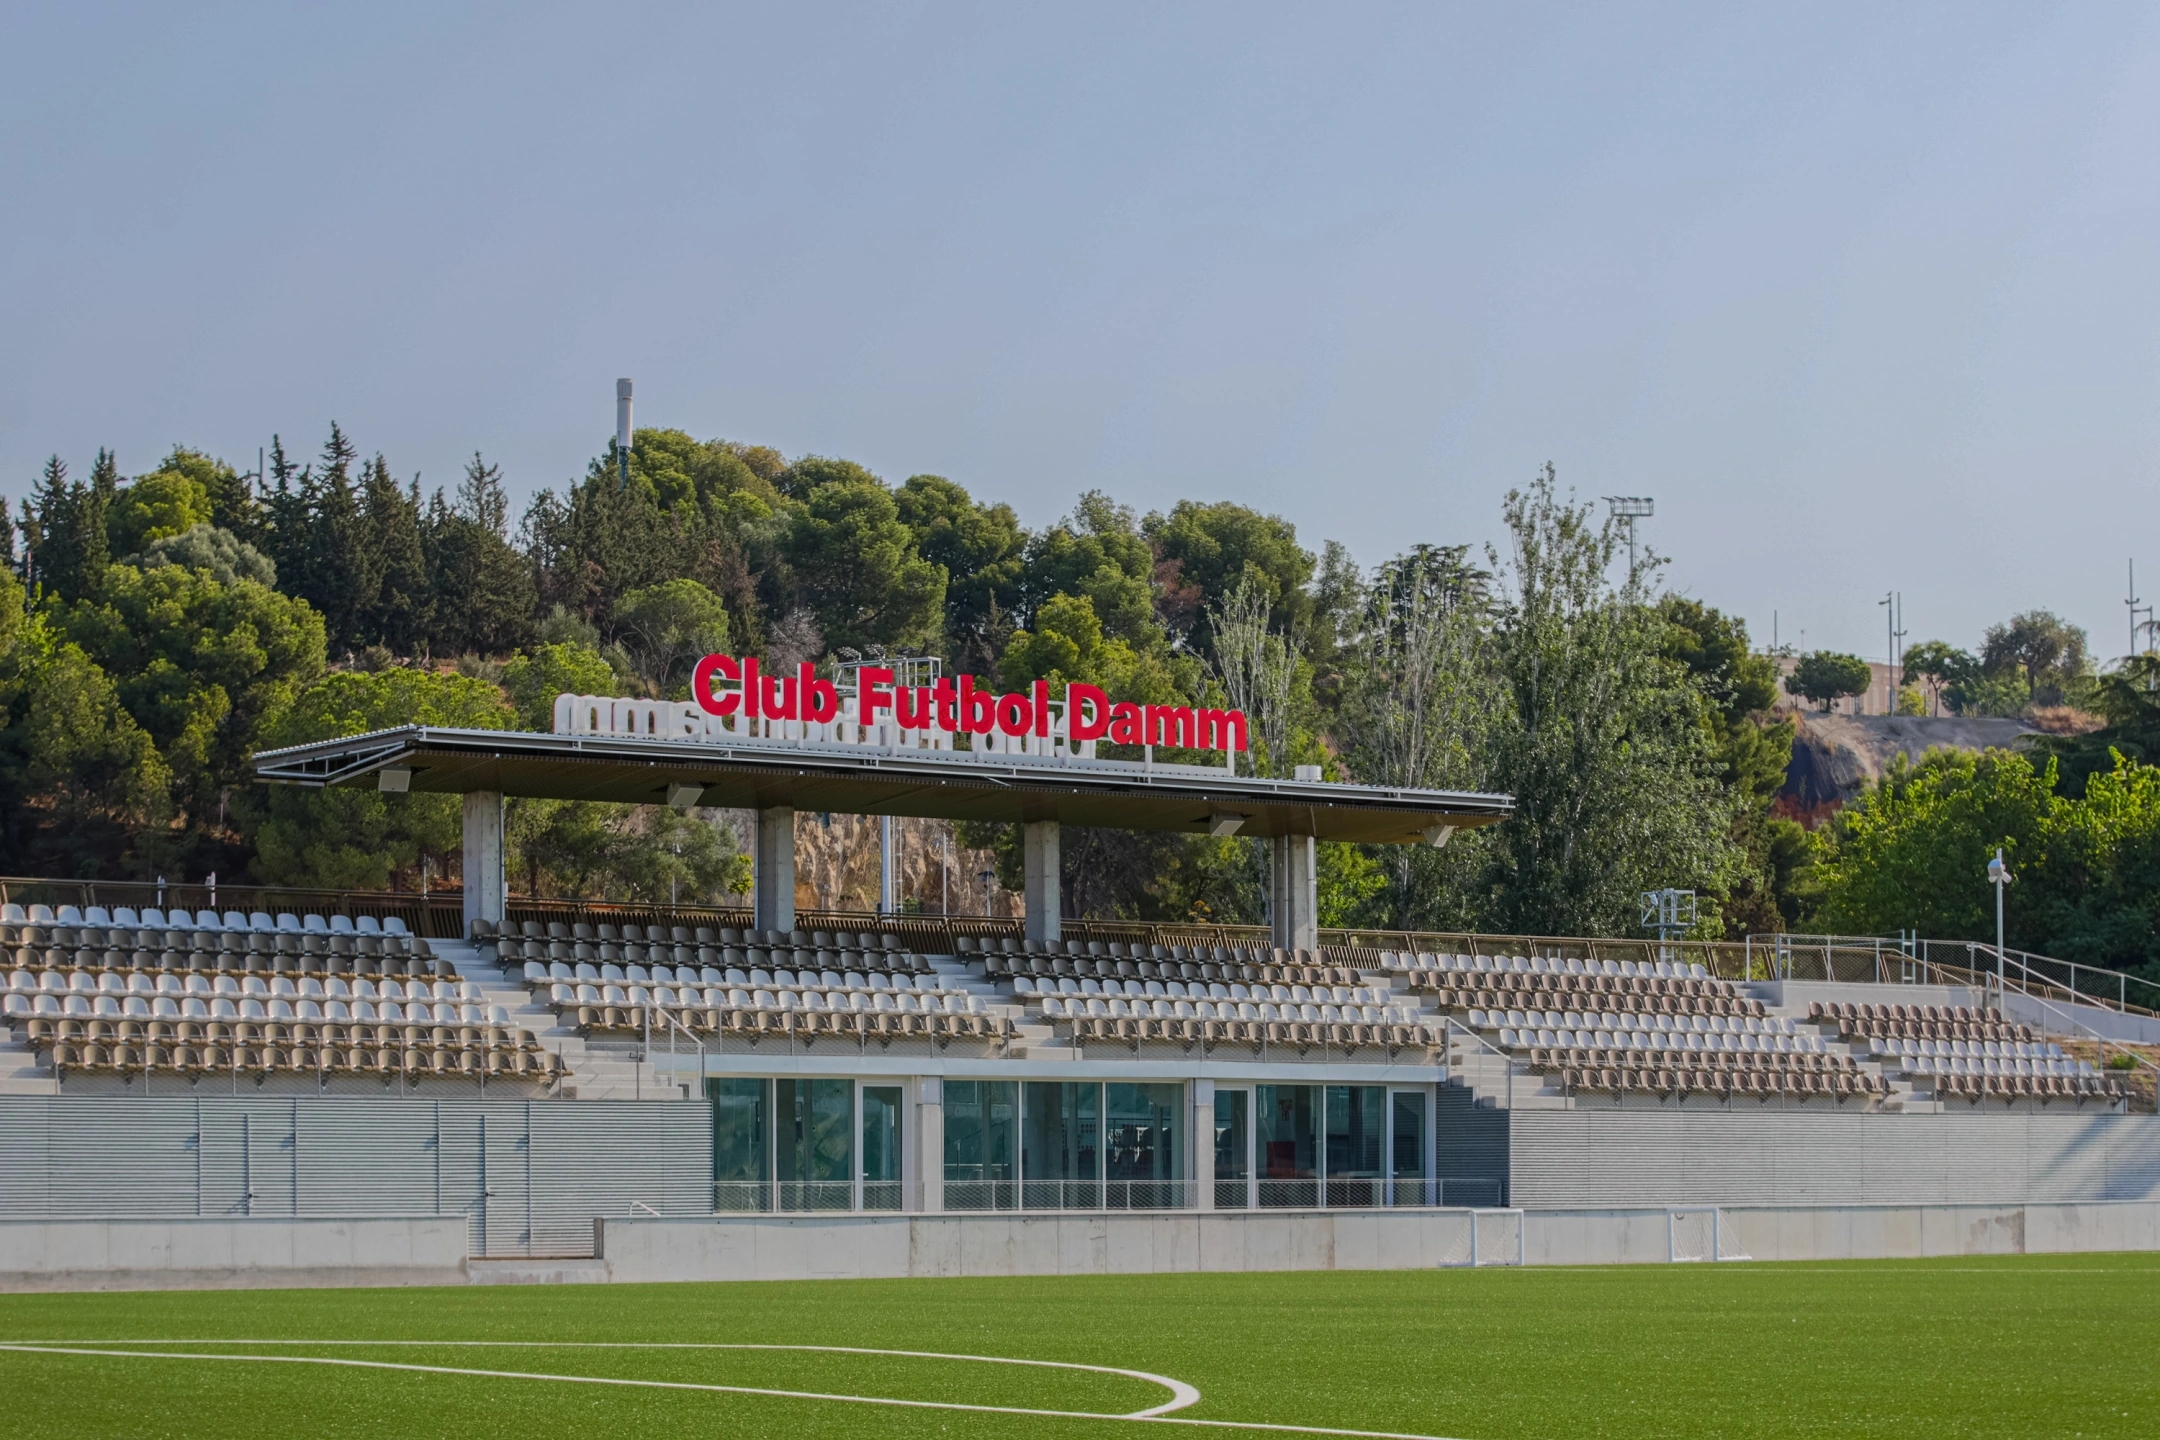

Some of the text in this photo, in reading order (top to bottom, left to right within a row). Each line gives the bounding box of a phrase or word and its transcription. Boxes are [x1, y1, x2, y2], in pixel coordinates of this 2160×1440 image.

[692, 652, 839, 724] Club
[858, 666, 1050, 738] Futbol
[1067, 682, 1248, 753] Damm
